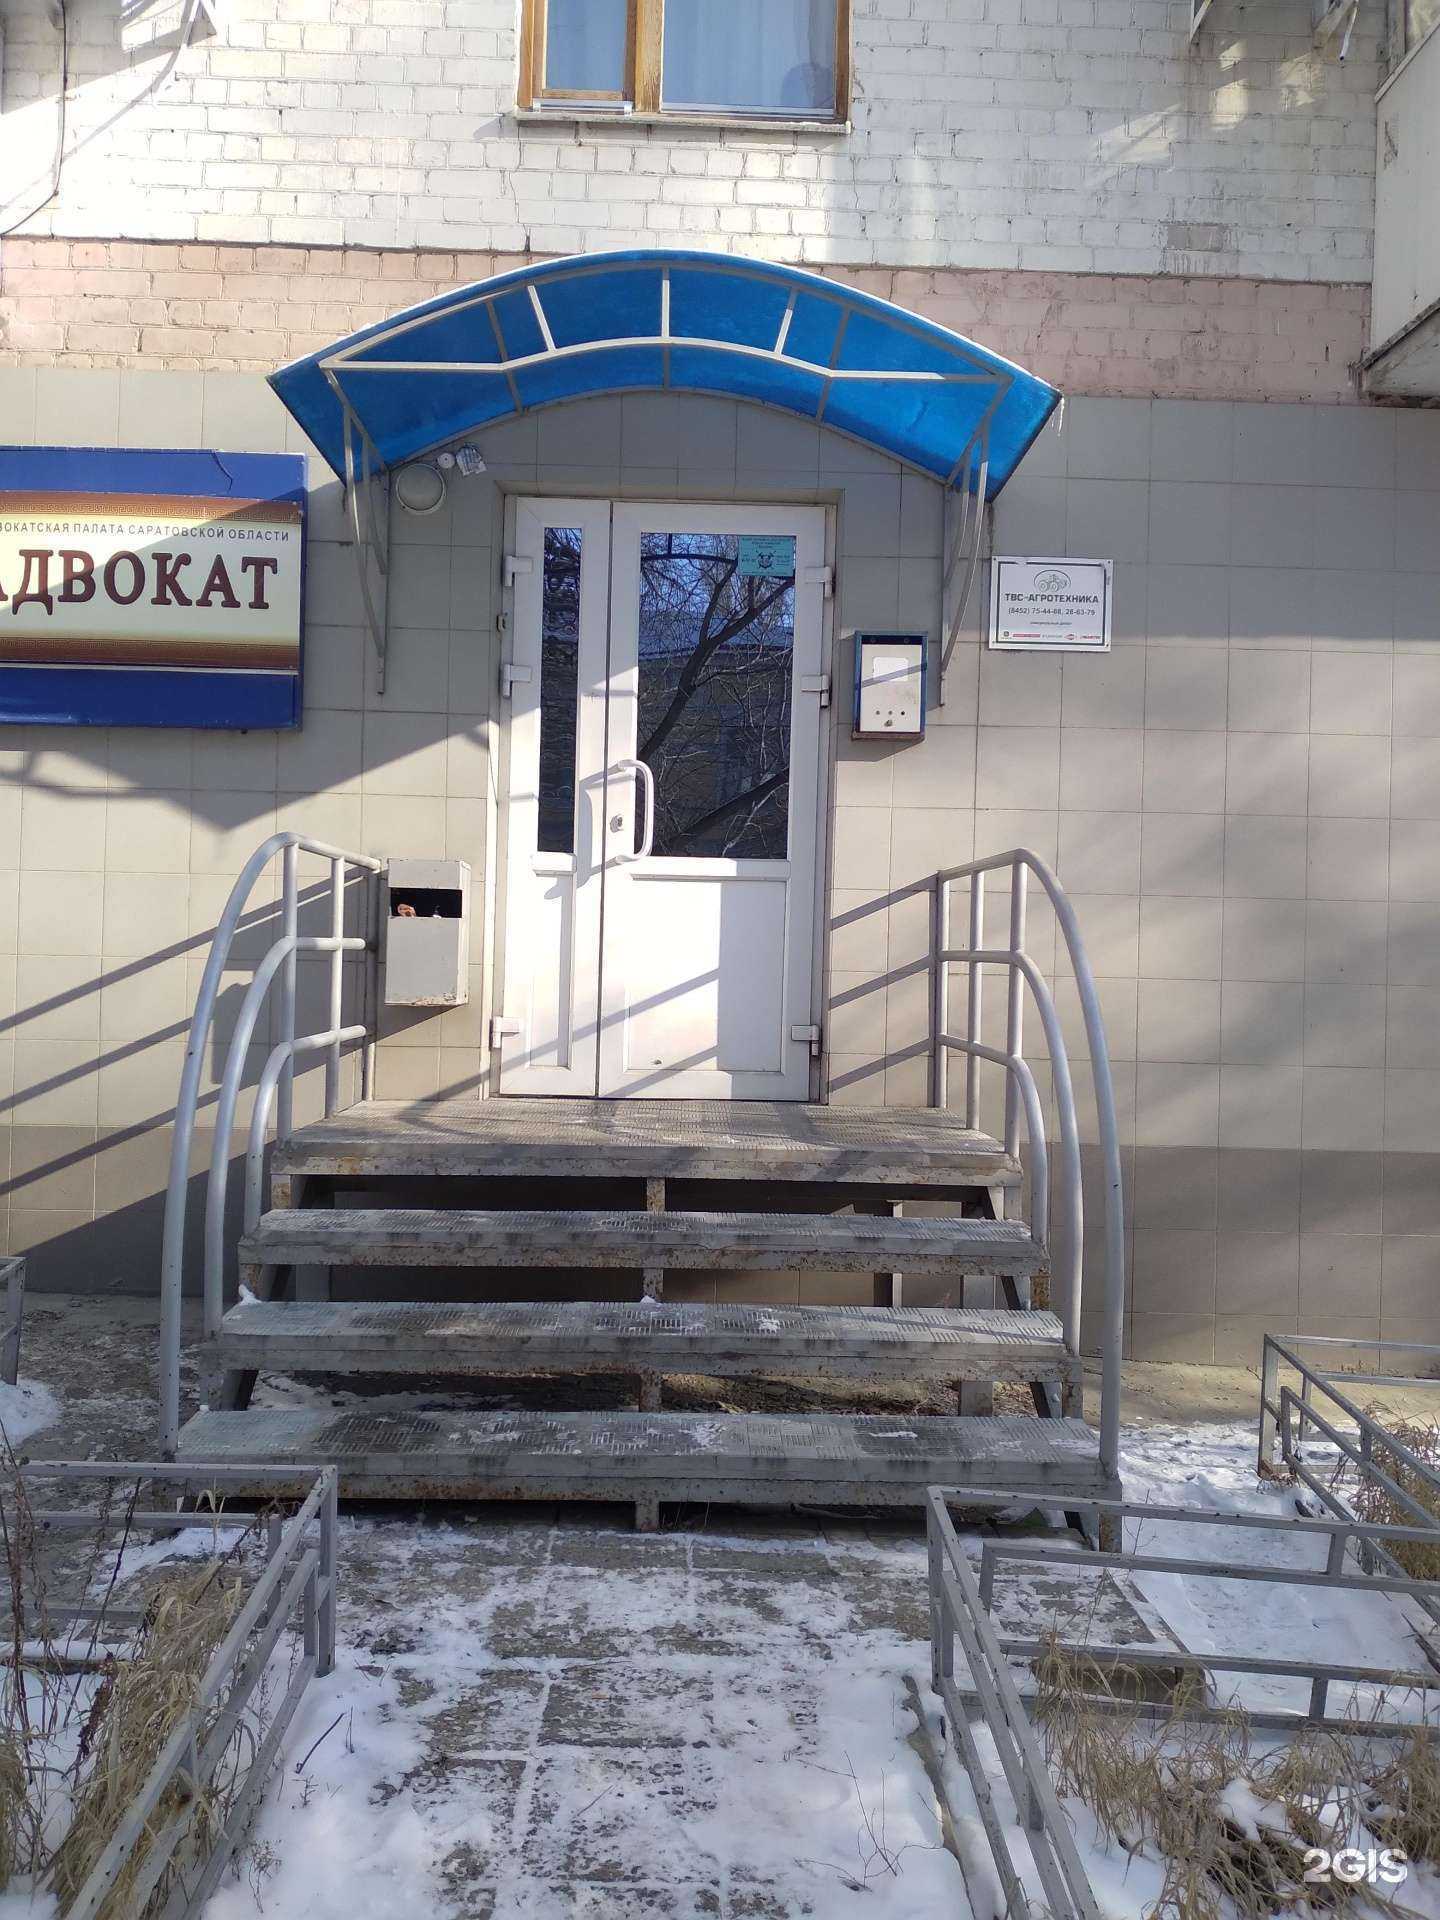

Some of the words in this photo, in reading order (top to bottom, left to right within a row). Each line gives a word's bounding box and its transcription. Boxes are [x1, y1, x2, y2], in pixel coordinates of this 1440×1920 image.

[73, 523, 124, 535] ПАЛАТА
[128, 525, 224, 538] САРАТОВСКОЙ
[229, 528, 289, 541] ОБЛАСТИ
[0, 550, 278, 615] ДВОКАТ
[1005, 593, 1099, 603] ТВС-АГРОТЕХНИКА
